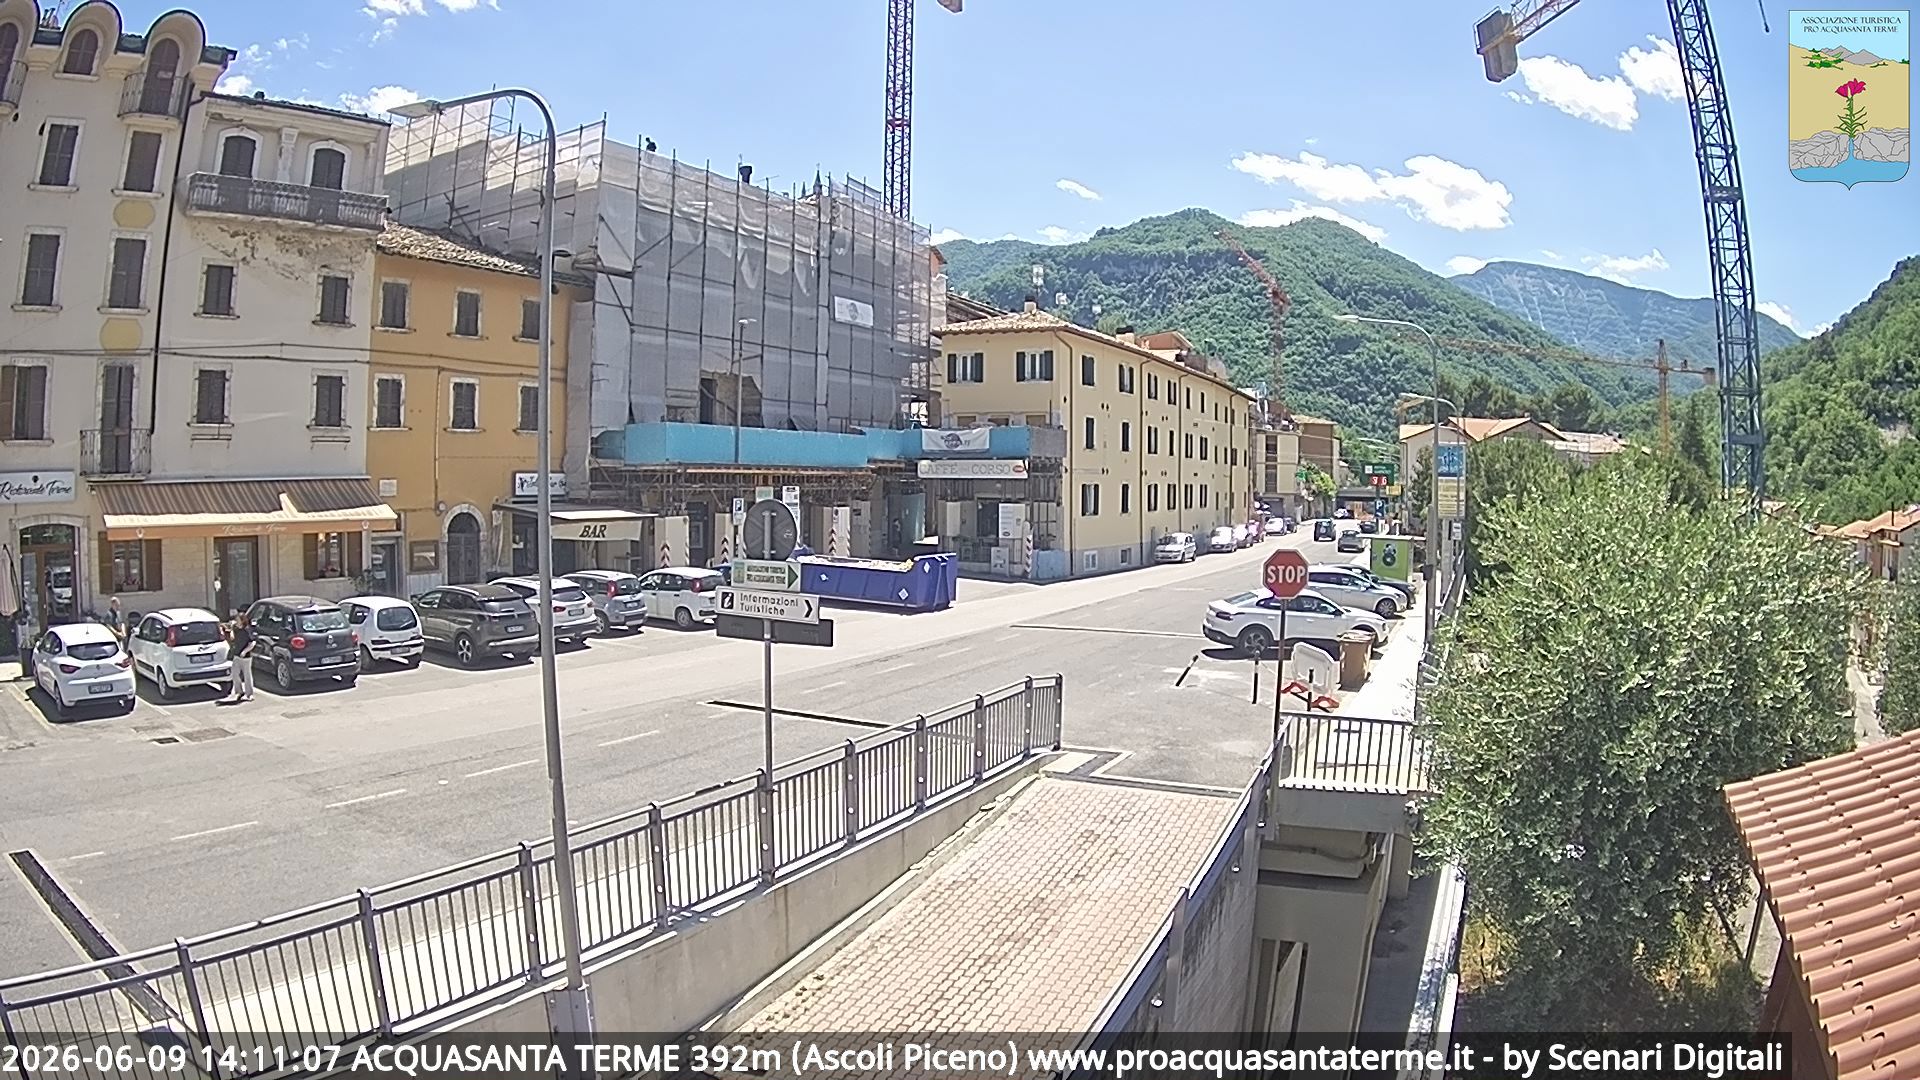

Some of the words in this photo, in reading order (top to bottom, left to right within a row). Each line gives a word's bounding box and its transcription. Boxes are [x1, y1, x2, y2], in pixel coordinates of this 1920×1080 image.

[971, 464, 1010, 475] CORSO
[579, 524, 607, 538] BAR
[1267, 565, 1306, 583] STOP
[740, 593, 799, 607] Informazioni
[740, 603, 785, 616] Turistiche
